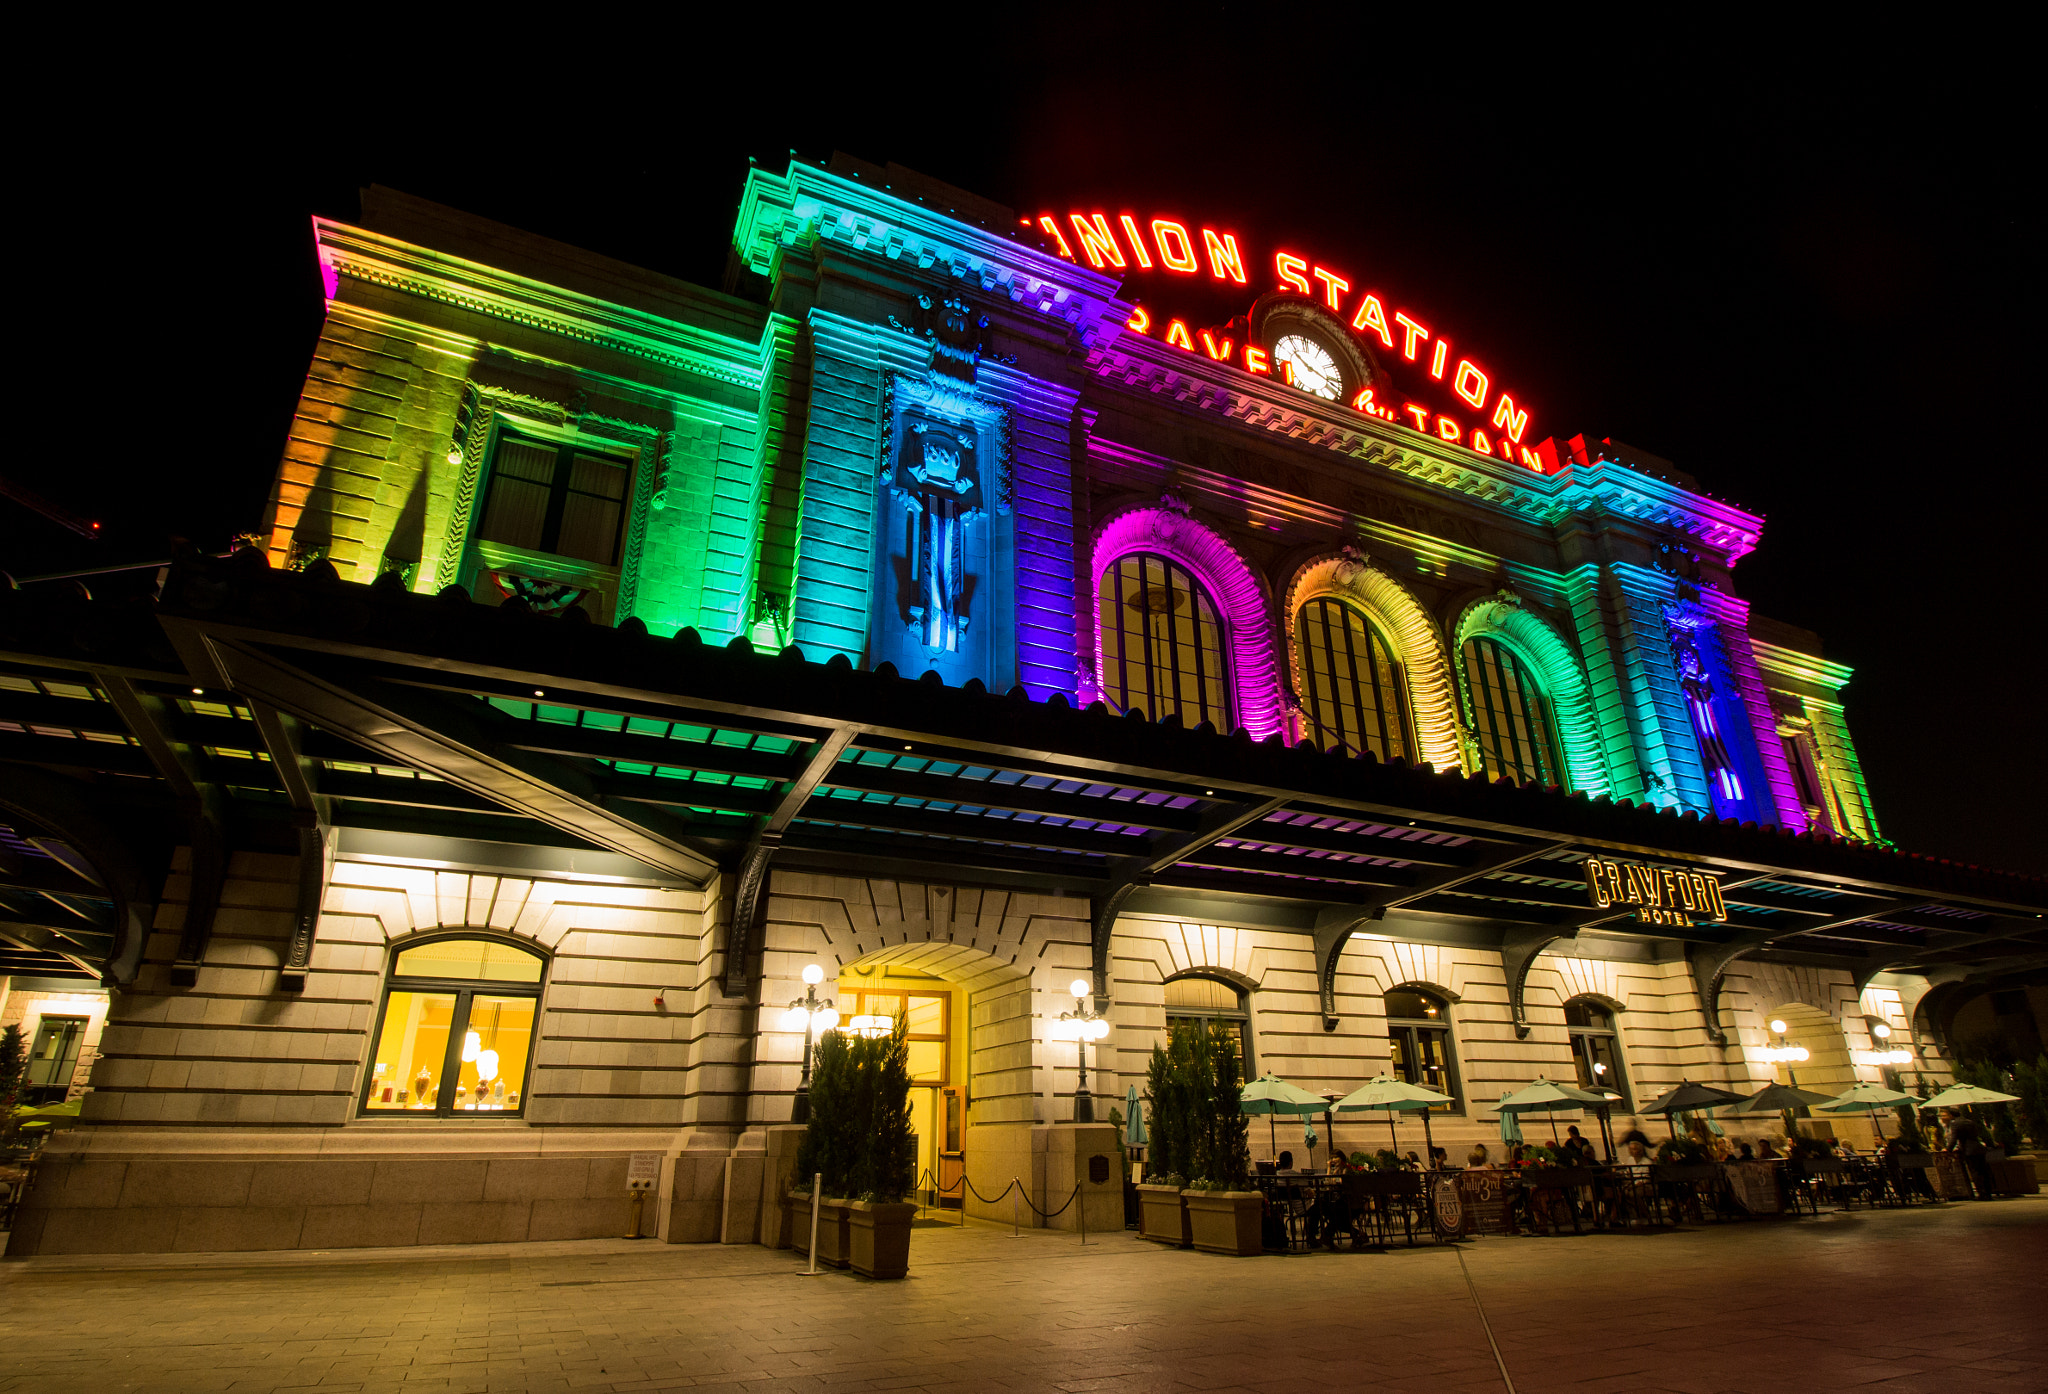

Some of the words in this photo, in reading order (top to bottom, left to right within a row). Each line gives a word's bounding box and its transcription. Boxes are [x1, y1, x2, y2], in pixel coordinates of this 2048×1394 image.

[1275, 251, 1529, 444] STATION
[1585, 858, 1728, 922] CRAWFORD
[1638, 907, 1695, 928] HOTEL
[1440, 1202, 1459, 1215] FEST
